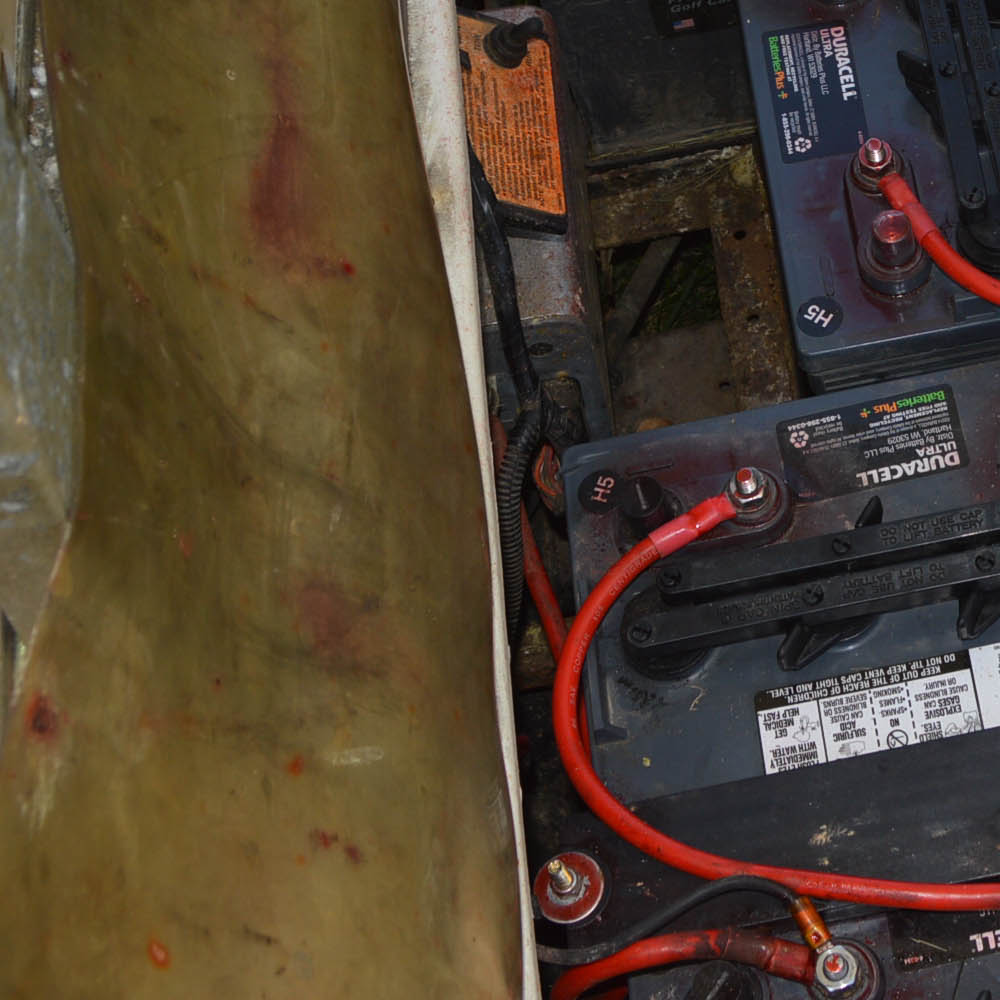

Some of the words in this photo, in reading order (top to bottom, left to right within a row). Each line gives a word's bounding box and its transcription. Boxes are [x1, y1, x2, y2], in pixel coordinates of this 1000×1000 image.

[818, 28, 832, 58] ULTRA
[814, 50, 824, 72] Batteries
[829, 26, 857, 101] DURACELL
[818, 72, 827, 83] Plus
[821, 84, 829, 95] LLC
[803, 304, 834, 328] H5
[886, 433, 909, 444] 53029
[909, 430, 920, 438] WI
[925, 435, 935, 444] By
[935, 431, 953, 441] Distr.
[878, 444, 894, 454] Plus
[894, 438, 924, 450] Batteries
[914, 440, 956, 457] ULTRA
[863, 448, 877, 457] LLC
[855, 450, 960, 486] DURACELL
[592, 476, 615, 502] H5
[903, 520, 925, 532] NOT
[931, 515, 954, 526] USE
[959, 509, 981, 521] CAP
[903, 528, 927, 540] LIFT
[933, 517, 984, 535] BATTERY
[924, 656, 942, 666] NOT
[942, 653, 955, 662] DO
[885, 663, 907, 674] KEEP
[908, 659, 923, 670] TIP.
[863, 667, 885, 679] VENT
[901, 669, 918, 680] OUT
[919, 665, 941, 676] KEEP
[815, 677, 837, 689] TIGHT
[839, 672, 862, 684] CAPS
[871, 676, 886, 686] THE
[887, 673, 900, 683] OF
[947, 676, 956, 685] OR
[794, 682, 813, 693] AND
[829, 686, 839, 695] OF
[840, 679, 870, 693] REACH
[948, 683, 968, 694] CAUSE
[765, 686, 793, 699] LEVEL.
[784, 688, 828, 704] CHILDREN.
[844, 692, 867, 703] SEVERE
[914, 687, 947, 701] BLINDNESS
[923, 699, 937, 709] CAN
[937, 694, 960, 706] GASES
[781, 706, 799, 717] HELP
[823, 708, 832, 716] OR
[833, 700, 867, 714] BLINDNESS
[923, 703, 962, 719] EXPLOSIVE
[760, 710, 780, 722] FAST.
[829, 712, 849, 723] CAUSE
[850, 709, 863, 719] CAN
[762, 716, 794, 731] MEDICAL
[839, 719, 856, 730] ACID
[889, 717, 899, 726] NO
[920, 720, 941, 732] EYES.
[774, 727, 787, 738] GET
[832, 727, 866, 742] SULFURIC
[769, 744, 797, 758] WATER.
[798, 740, 816, 752] WITH
[769, 749, 818, 768] IMMEDIATELY
